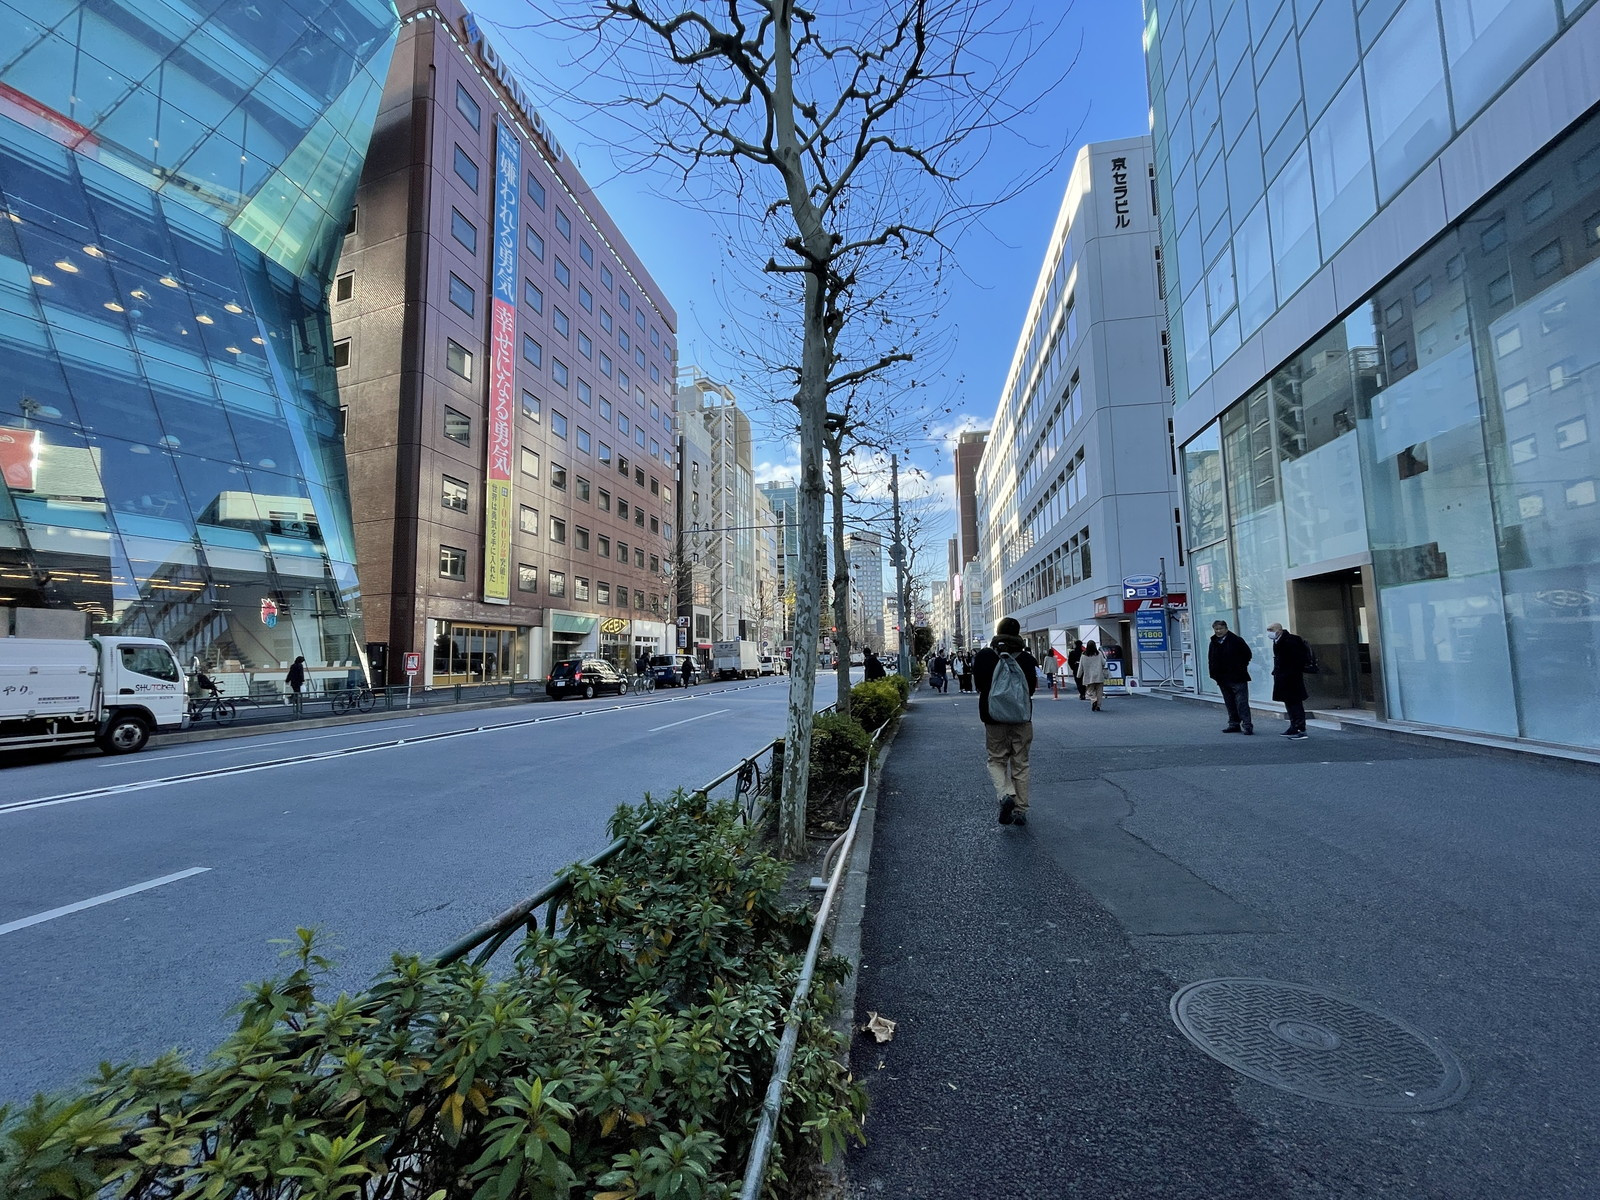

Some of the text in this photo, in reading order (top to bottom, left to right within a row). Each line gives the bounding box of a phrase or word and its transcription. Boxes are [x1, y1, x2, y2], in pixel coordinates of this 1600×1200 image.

[481, 34, 564, 163] DIAMOND
[1111, 157, 1130, 230] 京セラビル
[497, 151, 517, 302] 嫌われる勇気
[492, 305, 513, 476] 幸せになる勇気
[488, 483, 498, 583] 世界は勇気を手に入れた
[1126, 588, 1136, 598] P
[601, 618, 627, 633] KEEN
[679, 617, 685, 627] P
[3, 685, 34, 696] やり。
[135, 683, 176, 692] SHUTOKEN
